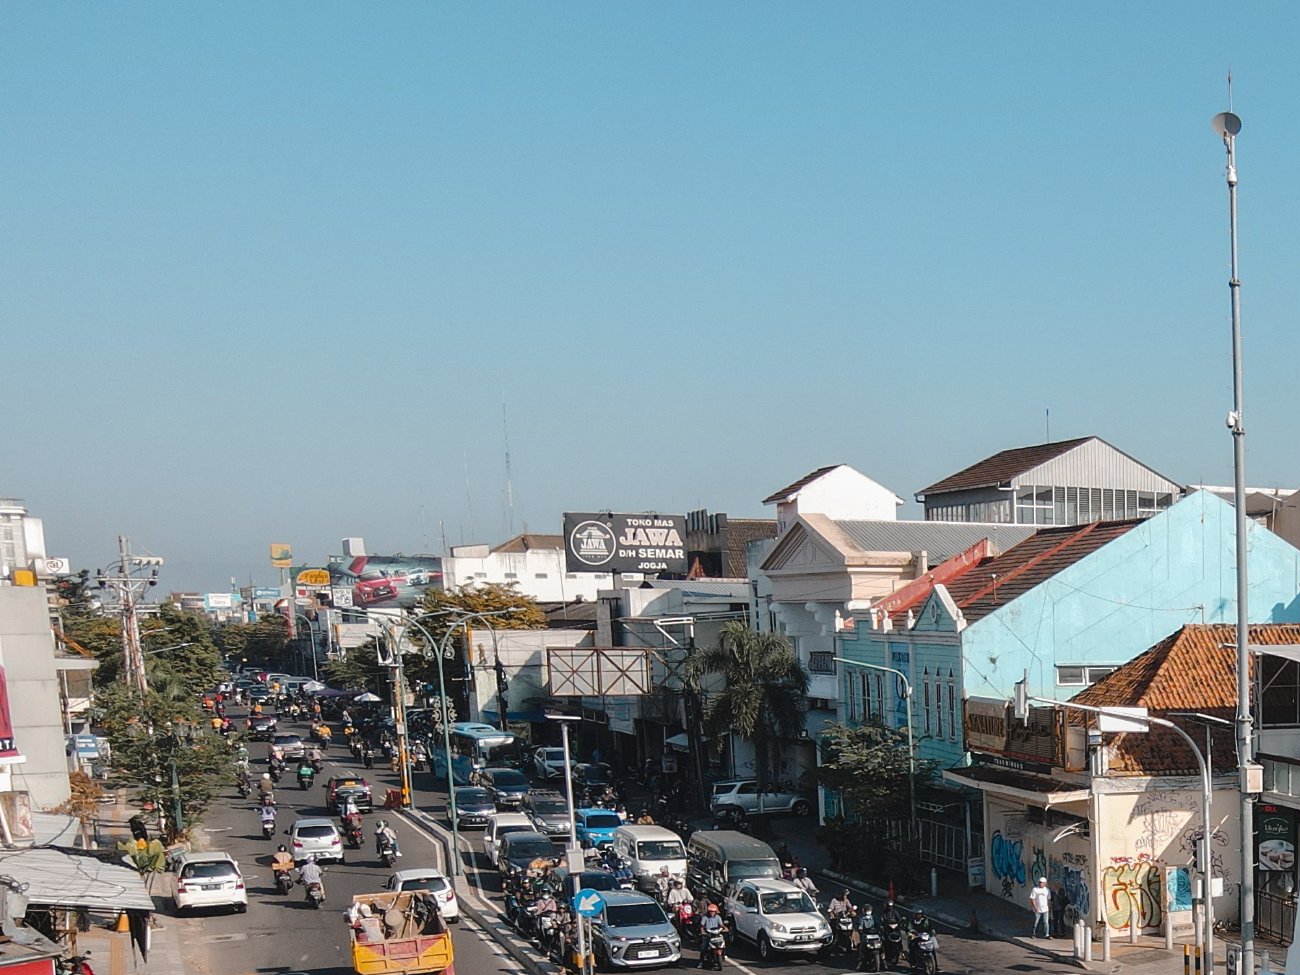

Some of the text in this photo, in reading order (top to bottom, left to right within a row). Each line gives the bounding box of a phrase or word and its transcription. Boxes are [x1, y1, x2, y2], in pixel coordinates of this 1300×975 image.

[626, 518, 674, 527] TOKO MAS
[619, 528, 683, 546] JAWA
[580, 538, 606, 549] JAWA
[619, 549, 684, 559] D/H SEMAR
